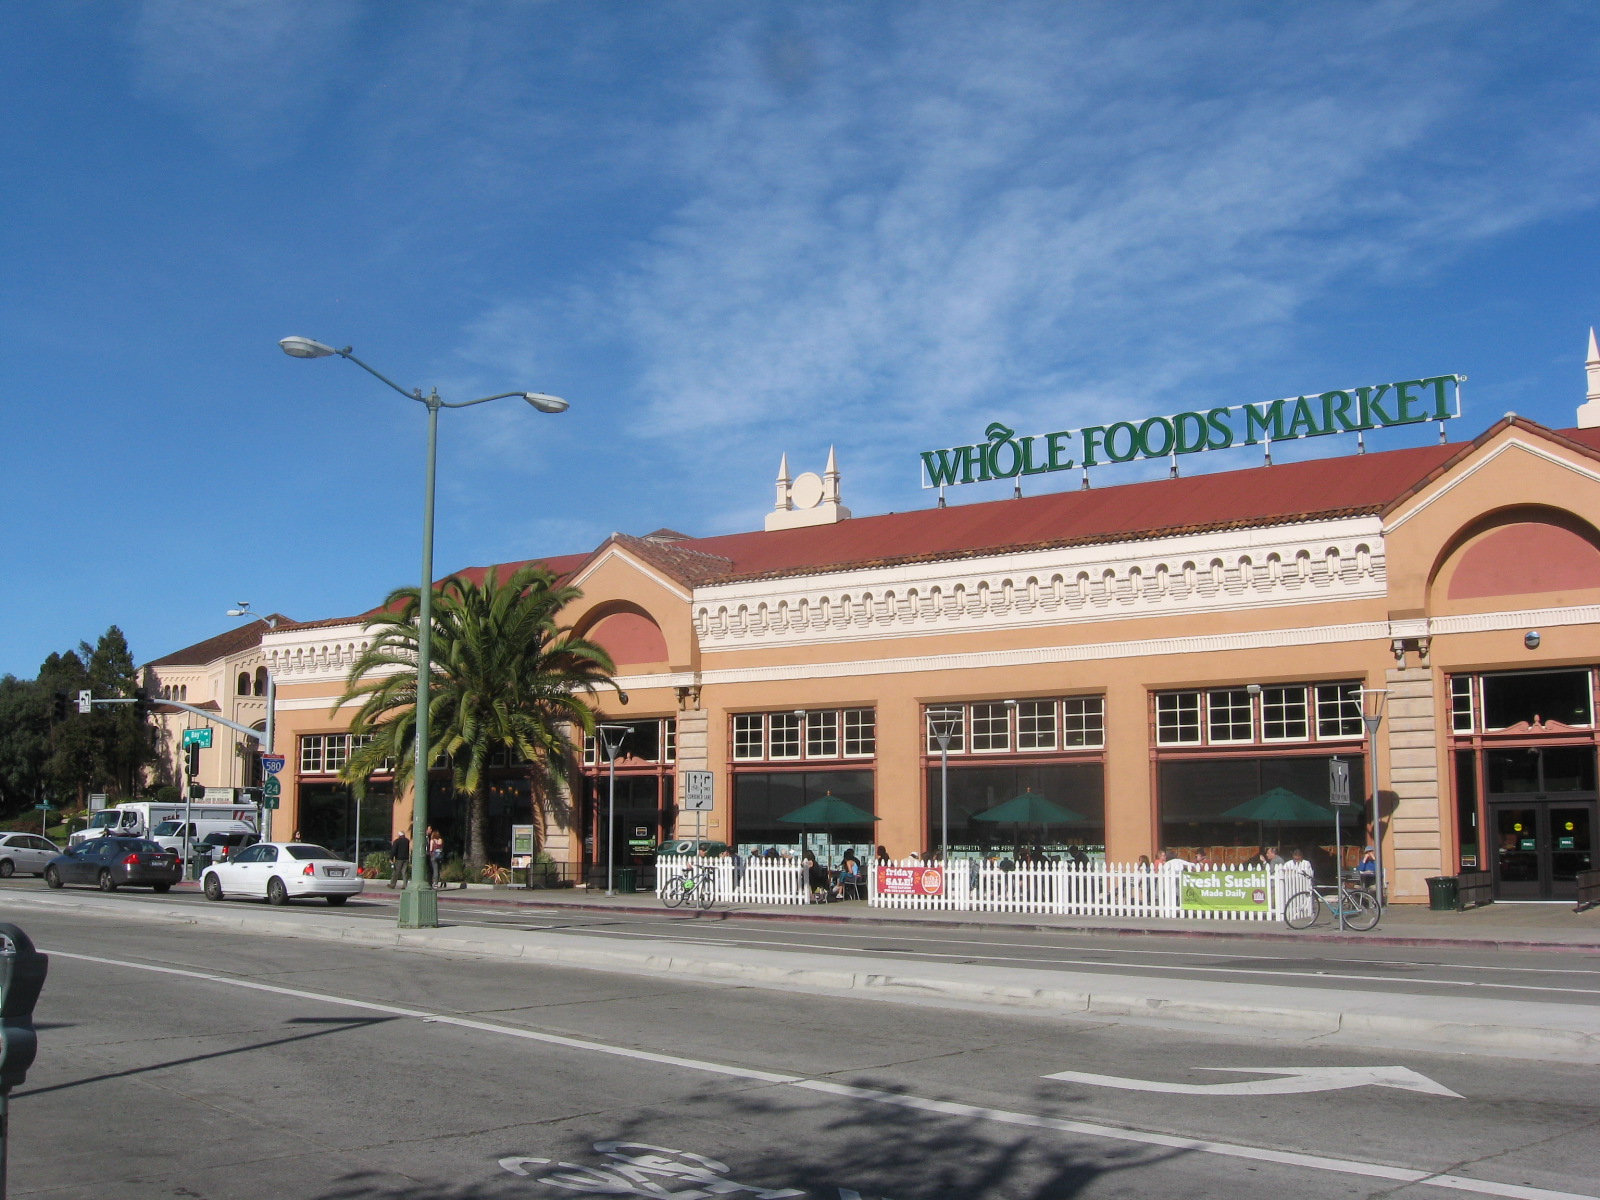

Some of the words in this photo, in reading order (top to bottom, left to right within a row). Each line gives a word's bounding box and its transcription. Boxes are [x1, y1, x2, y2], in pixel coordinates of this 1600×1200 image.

[921, 422, 1074, 488] WHOLE
[1081, 407, 1235, 468] FOODS
[1243, 375, 1459, 446] MARKET
[266, 761, 282, 772] 580
[266, 784, 279, 794] 24
[885, 868, 914, 878] friday
[885, 878, 914, 887] SALE!
[1182, 874, 1220, 887] Fresh
[1224, 874, 1266, 887] Sushi
[1201, 889, 1224, 897] Made
[1225, 889, 1246, 899] Daily
